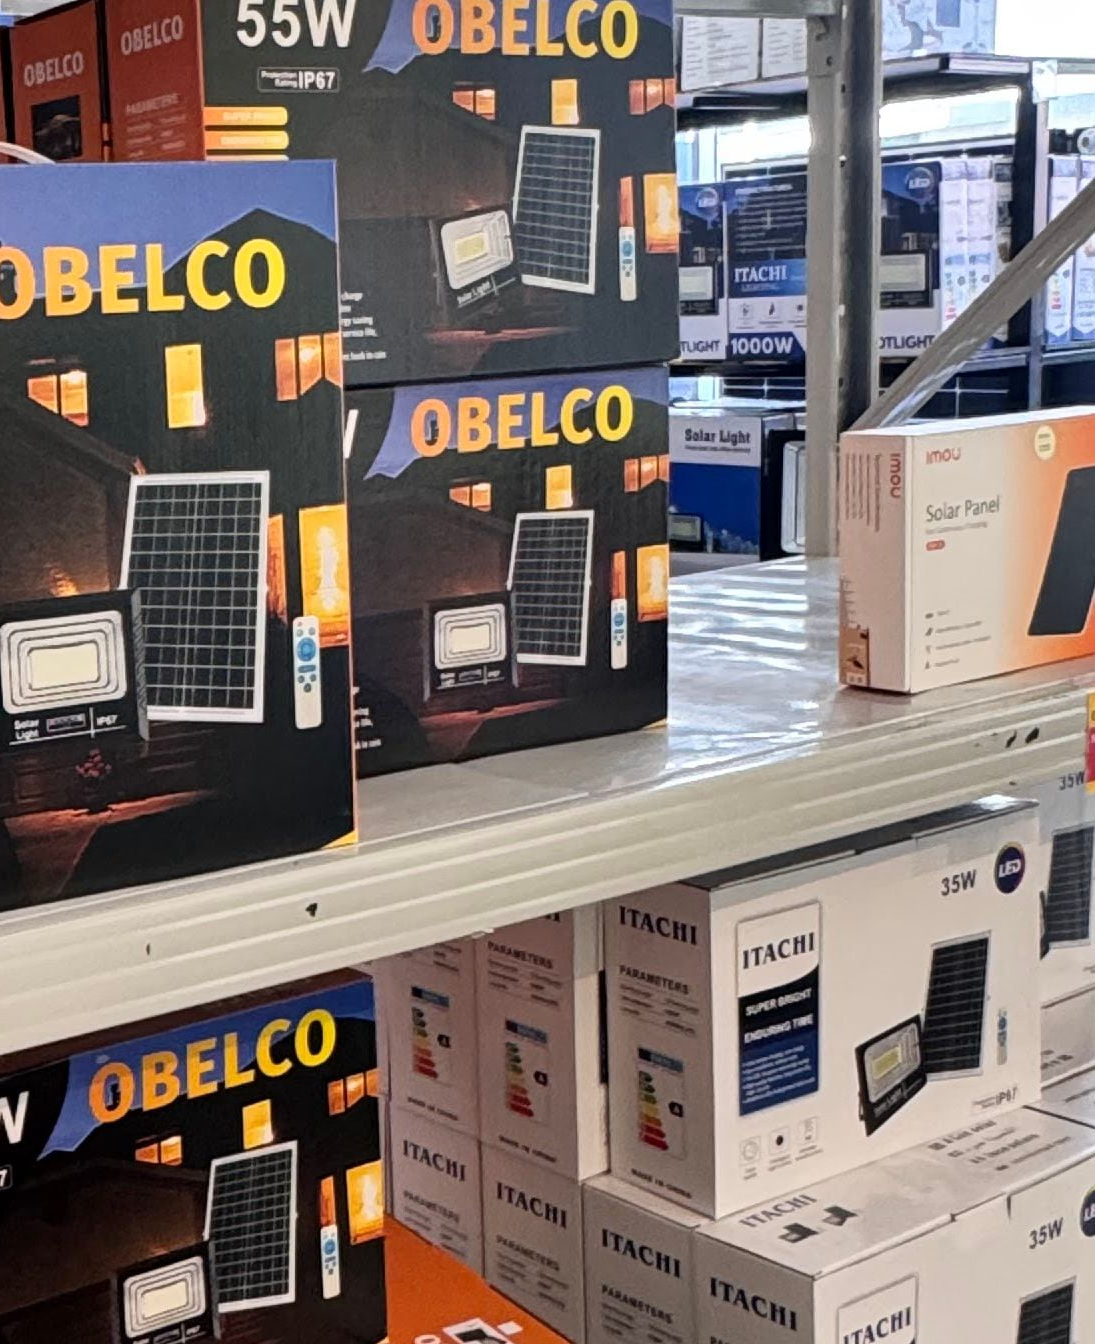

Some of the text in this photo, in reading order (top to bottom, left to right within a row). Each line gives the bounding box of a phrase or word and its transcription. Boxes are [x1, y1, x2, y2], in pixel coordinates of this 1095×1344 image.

[120, 14, 185, 57] OBELCO
[23, 51, 85, 89] OBELCO
[734, 264, 788, 283] ITACHI
[731, 336, 794, 356] 1000W
[410, 384, 634, 458] OBELCO
[685, 427, 751, 445] Solar Light
[926, 494, 1001, 524] Solar Panel
[940, 859, 1022, 897] 35W LED
[618, 905, 698, 947] ITACHI
[742, 931, 816, 970] ITACHI
[619, 964, 690, 995] PARAMETERS
[745, 987, 813, 1017] SUPER BRIGHT
[88, 1007, 337, 1124] OBELCO
[402, 1138, 467, 1183] ITACHI
[496, 1181, 568, 1230] ITACHI
[601, 1227, 682, 1279] ITACHI
[709, 1276, 799, 1332] ITACHI
